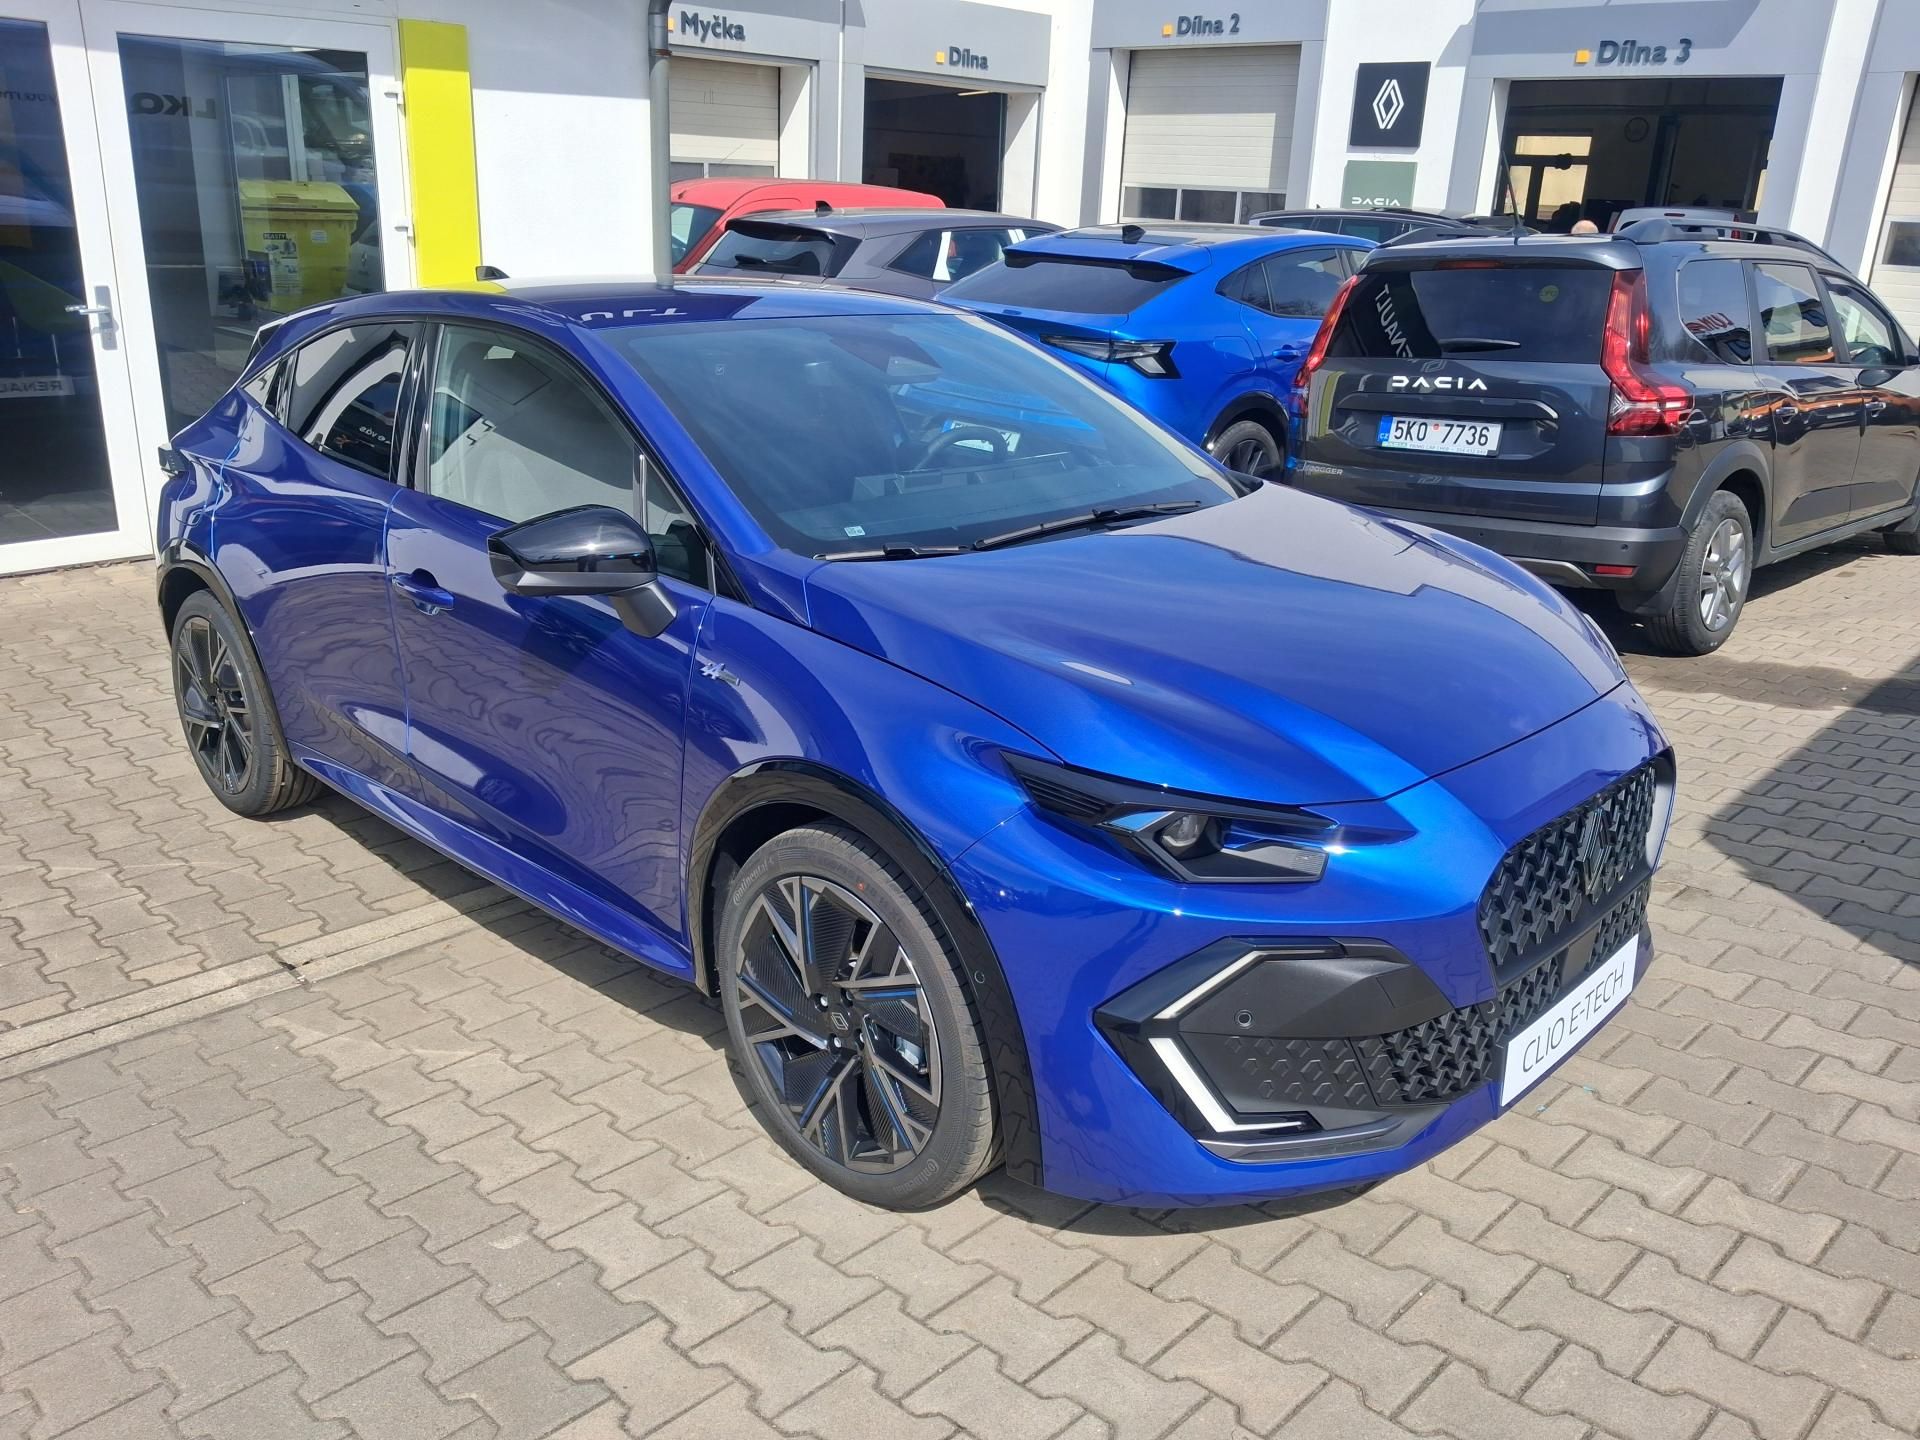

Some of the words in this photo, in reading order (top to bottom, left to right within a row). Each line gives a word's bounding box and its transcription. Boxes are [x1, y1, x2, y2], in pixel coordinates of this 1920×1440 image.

[680, 11, 746, 42] Myčka
[1177, 15, 1224, 35] Dílna
[1229, 13, 1240, 34] 2
[948, 46, 989, 70] Dílna
[1597, 40, 1667, 65] Dílna
[1675, 38, 1692, 63] 3
[1351, 196, 1401, 207] DACIA
[1392, 375, 1488, 391] DACIA
[1394, 420, 1428, 442] 5K0
[1441, 423, 1490, 447] 7736
[1522, 1017, 1565, 1073] CLIO
[1569, 961, 1625, 1036] E-TECH
